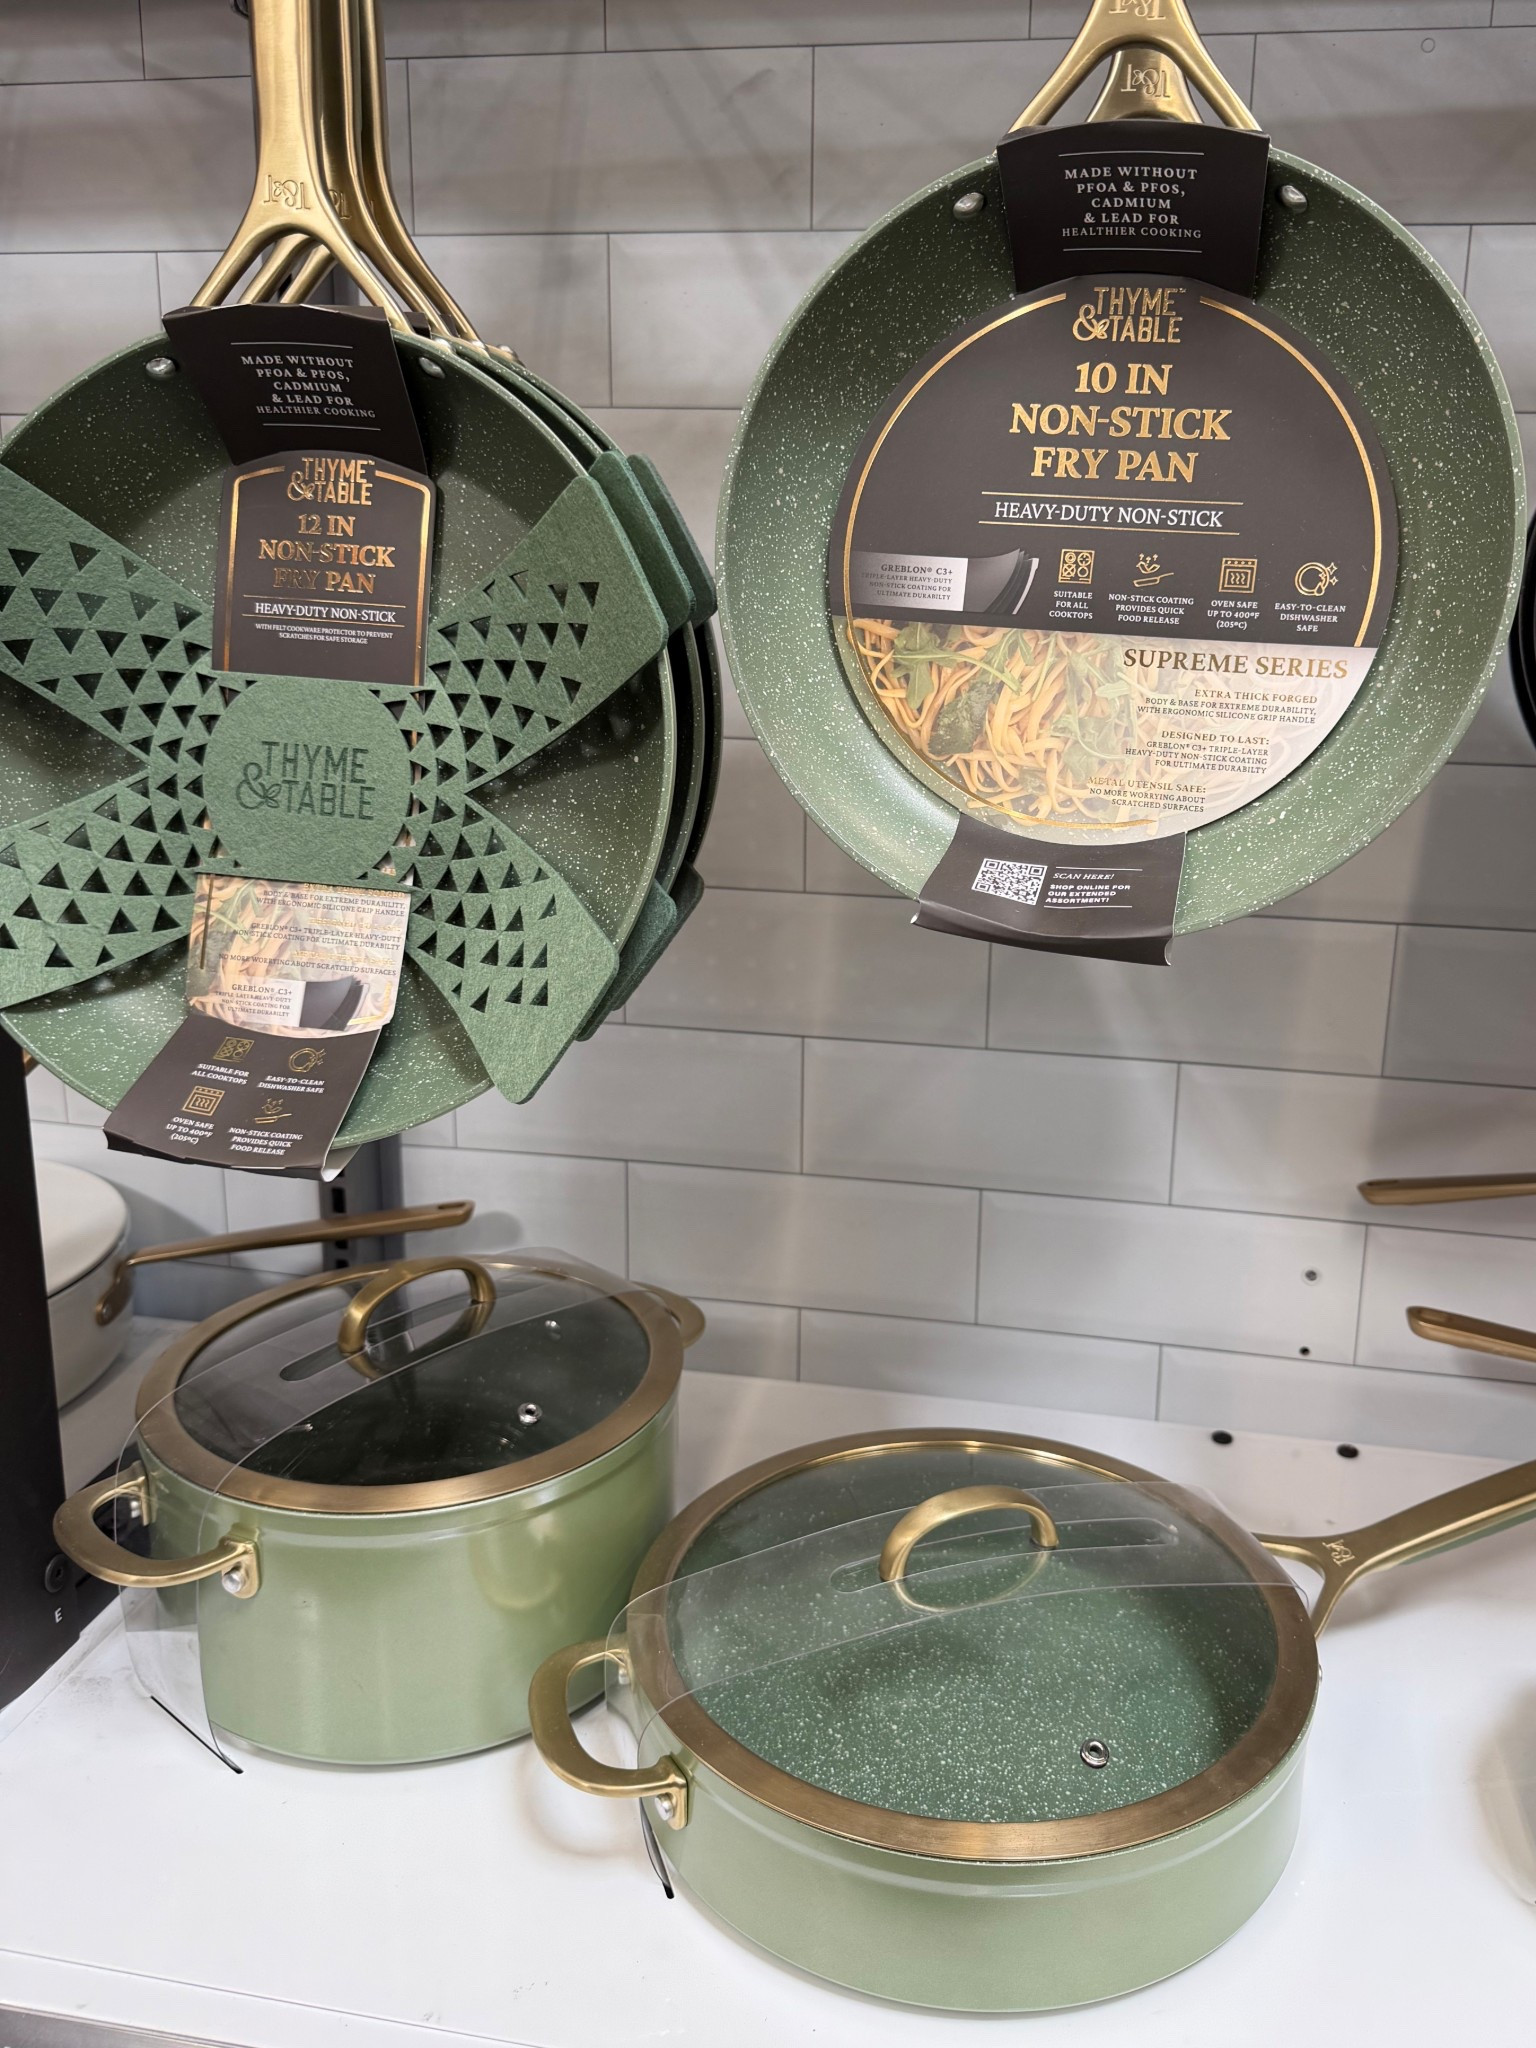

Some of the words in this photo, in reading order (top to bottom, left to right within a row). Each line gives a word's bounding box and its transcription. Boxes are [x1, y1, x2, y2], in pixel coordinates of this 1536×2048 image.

[1064, 166, 1112, 180] MADE
[1117, 166, 1198, 180] WITHOUT
[1076, 182, 1117, 194] PFOA
[1122, 181, 1135, 192] &
[1140, 182, 1186, 197] PFOS,
[1091, 198, 1171, 209] CADMIUM
[1083, 212, 1096, 224] &
[1101, 212, 1143, 223] LEAD
[1148, 213, 1180, 225] FOR
[1062, 226, 1136, 237] HEALTHIER
[1140, 227, 1201, 239] COOKING
[1109, 315, 1183, 343] TABLE
[240, 355, 283, 365] MADE
[286, 355, 353, 368] WITHOUT
[256, 368, 293, 378] PFOA
[296, 367, 307, 378] &
[310, 369, 350, 382] PFOS,
[1074, 361, 1117, 394] 10
[1124, 363, 1173, 395] IN
[273, 381, 342, 393] CADMIUM
[272, 394, 283, 403] &
[286, 394, 322, 404] LEAD
[326, 396, 354, 406] FOR
[256, 406, 321, 415] HEALTHIER
[324, 407, 376, 418] COOKING
[1009, 402, 1232, 441] NON-STICK
[1030, 446, 1109, 479] FRY
[1115, 450, 1199, 483] PAN
[315, 481, 373, 506] TABLE
[994, 501, 1113, 523] HEAVY-DUTY
[1117, 507, 1224, 528] NON-STICK
[298, 513, 322, 535] 12
[327, 515, 356, 537] IN
[258, 539, 396, 568] NON-STICK
[273, 567, 320, 590] FRY
[325, 570, 376, 594] PAN
[870, 581, 906, 589] NON-STICK
[907, 584, 937, 592] COATING
[909, 576, 952, 584] HEAVY-DUTY
[877, 590, 911, 598] ULTIMATE
[1053, 590, 1093, 600] SUITABLE
[1108, 593, 1155, 604] NON-STICK
[1155, 595, 1194, 606] COATING
[1055, 600, 1072, 609] FOR
[1073, 601, 1089, 610] ALL
[1115, 604, 1155, 614] PROVIDES
[1157, 606, 1185, 615] QUICK
[1211, 599, 1235, 609] OVEN
[1236, 600, 1258, 609] SAFE
[1274, 602, 1346, 613] EASY-TO-CLEAN
[255, 602, 328, 618] HEAVY-DUTY
[331, 608, 396, 623] NON-STICK
[1048, 610, 1093, 620] COOKTOPS
[1207, 609, 1219, 618] UP
[1220, 610, 1232, 619] TO
[1280, 613, 1338, 624] DISHWASHER
[1117, 614, 1140, 623] FOOD
[1140, 615, 1180, 625] RELEASE
[287, 625, 321, 634] COOKWARE
[321, 628, 357, 636] PROTECTOR
[366, 631, 394, 639] PREVENT
[1296, 623, 1318, 633] SAFE
[279, 632, 313, 640] SCRATCHES
[340, 636, 368, 644] STORAGE
[1123, 649, 1248, 674] SUPREME
[1255, 656, 1348, 679] SERIES
[1194, 689, 1232, 700] EXTRA
[1234, 691, 1269, 701] THICK
[1272, 693, 1318, 704] FORGED
[1145, 697, 1168, 706] BODY
[1169, 698, 1177, 706] &
[1178, 698, 1199, 708] BASE
[1200, 700, 1217, 709] FOR
[1218, 701, 1260, 712] EXTREME
[1261, 704, 1317, 716] DURABILITY,
[1137, 706, 1161, 715] WITH
[1162, 707, 1214, 718] ERGONOMIC
[1215, 710, 1255, 720] SILICONE
[1257, 712, 1277, 721] GRIP
[1278, 714, 1315, 724] HANDLE
[1161, 730, 1217, 742] DESIGNED
[1219, 733, 1235, 744] TO
[1238, 735, 1269, 745] LAST:
[1125, 747, 1179, 760] HEAVY-DUTY
[1180, 751, 1228, 762] NON-STICK
[1229, 755, 1268, 765] COATING
[1191, 743, 1208, 752] C3+
[1209, 745, 1269, 756] TRIPLE-LAYER
[261, 740, 369, 784] THYME
[1155, 759, 1172, 768] FOR
[1173, 760, 1216, 771] ULTIMATE
[1087, 775, 1125, 788] METAL
[1128, 779, 1174, 791] UTENSIL
[1175, 783, 1206, 793] SAFE:
[281, 779, 376, 821] TABLE
[1089, 787, 1102, 796] NO
[1103, 788, 1128, 798] MORE
[1129, 790, 1175, 802] WORRYING
[1176, 795, 1206, 804] ABOUT
[1111, 798, 1161, 809] SCRATCHED
[1162, 803, 1204, 813] SURFACES
[1053, 872, 1082, 880] SCAN
[278, 988, 293, 996] C3+
[197, 1063, 234, 1076] SUITABLE
[234, 1068, 249, 1077] FOR
[191, 1069, 207, 1078] ALL
[206, 1072, 247, 1085] COOKTOPS
[265, 1075, 325, 1086] EASY-TO-CLEAN
[256, 1082, 306, 1093] DISHWASHER
[306, 1086, 324, 1094] SAFE
[172, 1116, 194, 1126] OVEN
[195, 1120, 214, 1130] SAFE
[177, 1125, 189, 1134] TO
[229, 1127, 270, 1140] NON-STICK
[271, 1131, 303, 1141] COATING
[231, 1136, 267, 1147] PROVIDES
[268, 1139, 292, 1148] QUICK
[230, 1143, 252, 1153] FOOD
[253, 1146, 285, 1156] RELEASE
[54, 1607, 63, 1623] E
